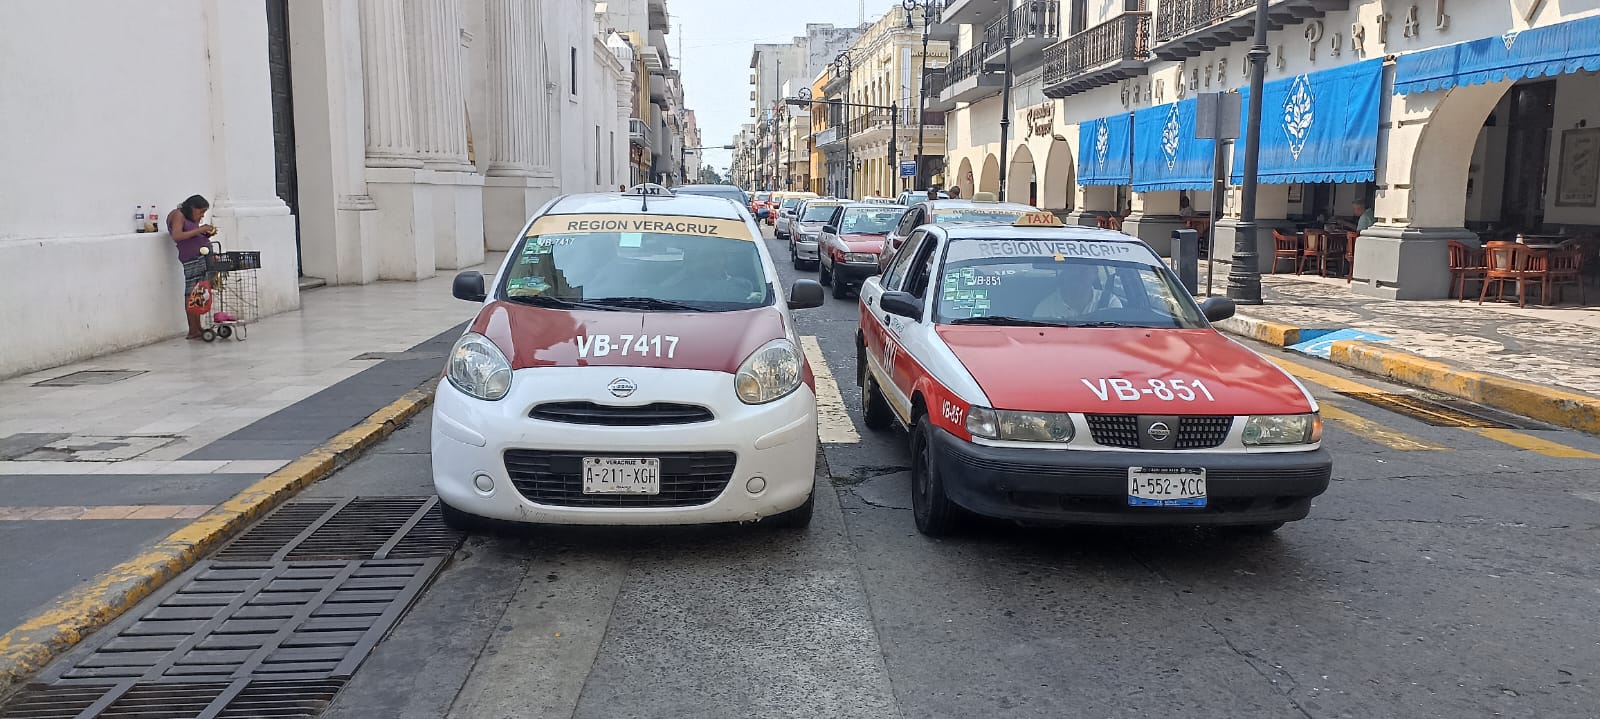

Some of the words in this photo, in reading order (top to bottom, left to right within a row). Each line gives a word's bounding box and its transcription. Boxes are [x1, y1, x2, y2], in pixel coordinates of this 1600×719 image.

[1241, 43, 1284, 79] DL
[636, 187, 660, 195] TAXI
[1025, 213, 1054, 225] TAXI
[567, 220, 628, 231] REGION
[632, 221, 718, 235] VERACRUZ
[538, 237, 575, 248] VB-7417
[978, 242, 1042, 256] REGION
[972, 275, 1002, 286] VB-851
[576, 334, 679, 359] VB-7417
[1080, 377, 1215, 402] VB-851
[942, 399, 963, 426] VB-851
[586, 467, 656, 484] A-211-XGH
[1132, 478, 1204, 496] A-552-XCC
